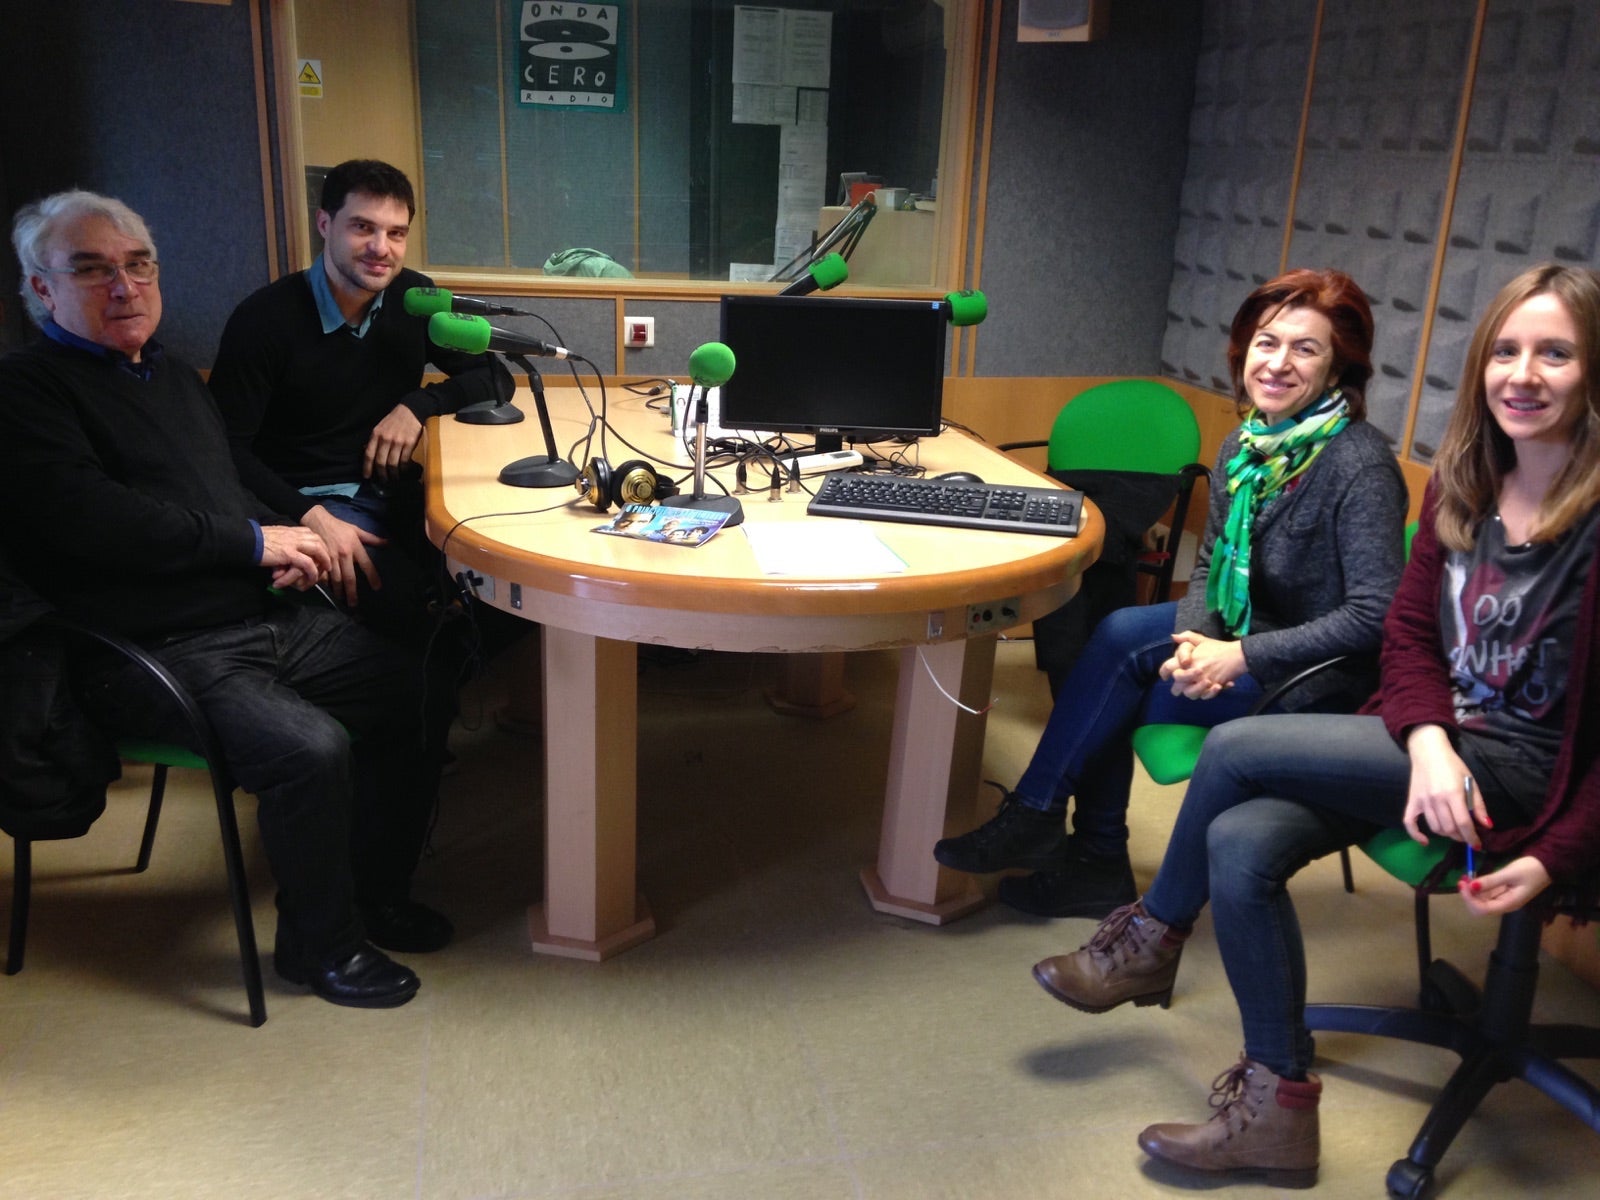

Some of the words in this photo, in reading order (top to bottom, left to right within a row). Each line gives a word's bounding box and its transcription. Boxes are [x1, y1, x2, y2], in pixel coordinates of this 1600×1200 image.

[531, 3, 608, 20] ONDA
[524, 64, 606, 87] CERO
[526, 93, 608, 103] RADIO
